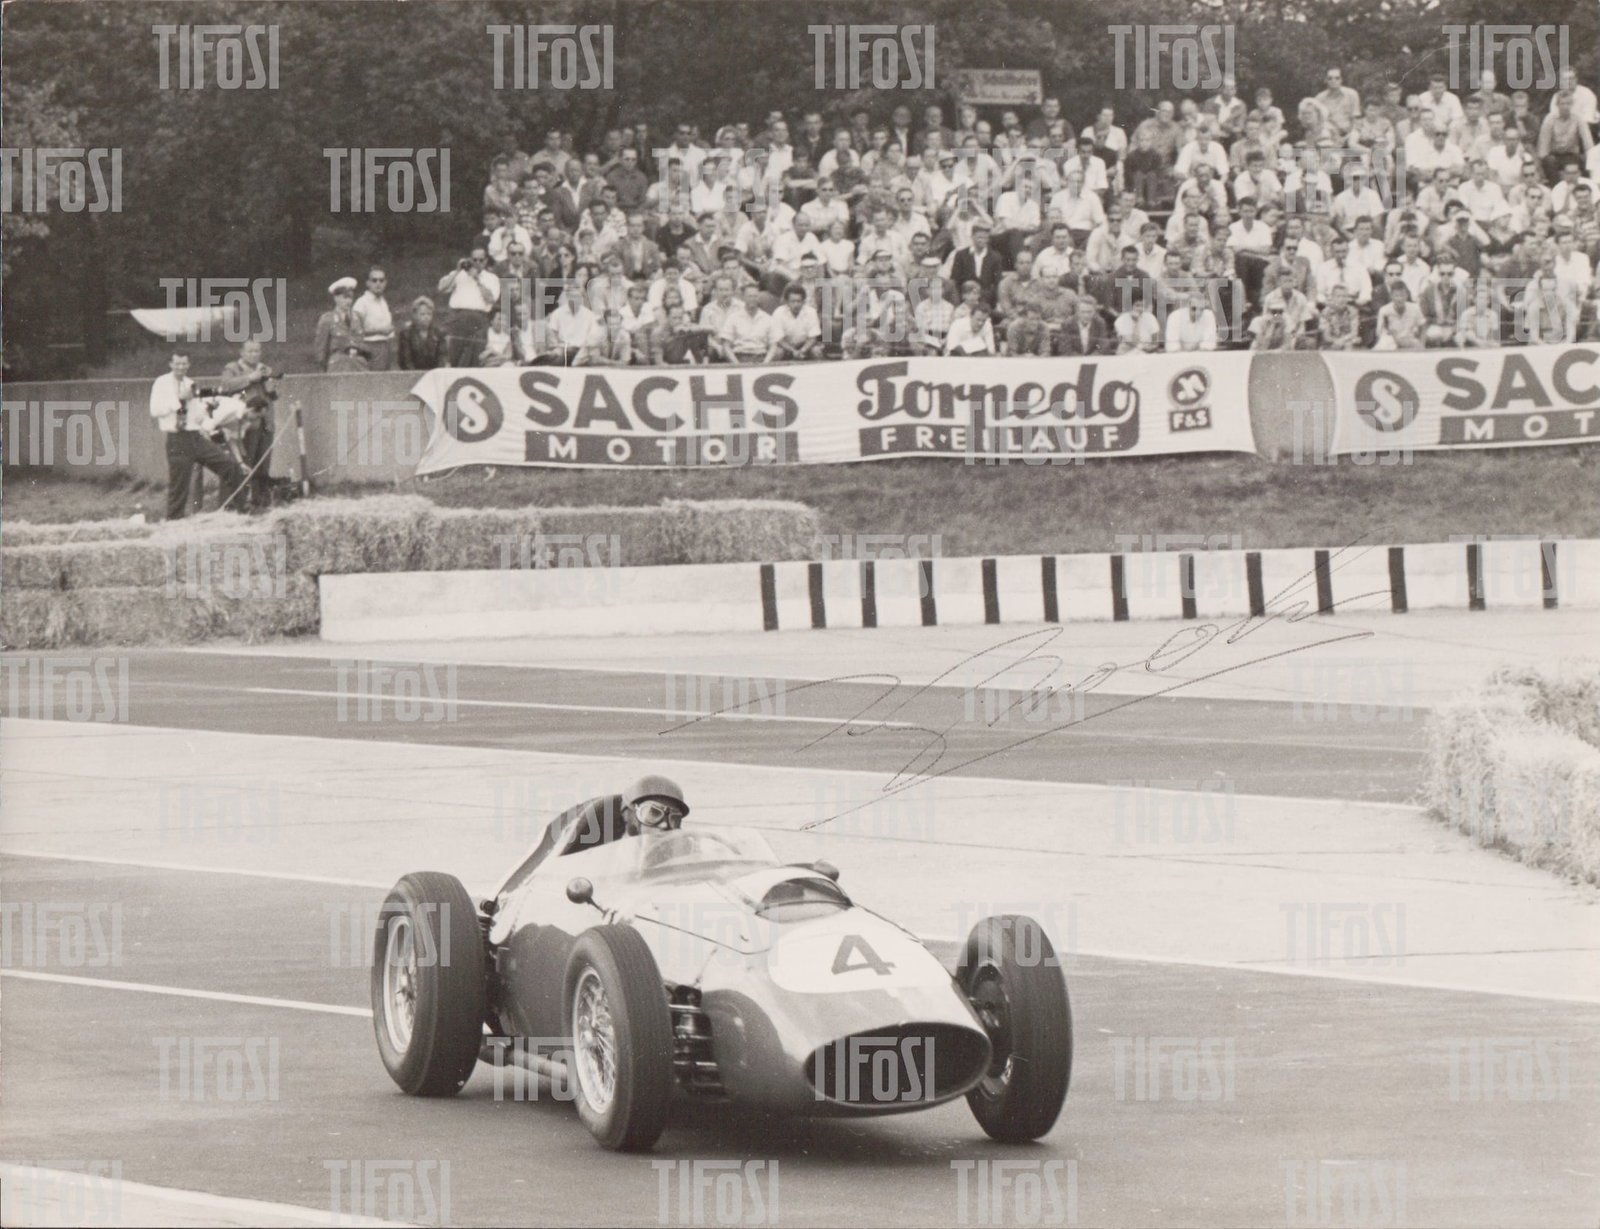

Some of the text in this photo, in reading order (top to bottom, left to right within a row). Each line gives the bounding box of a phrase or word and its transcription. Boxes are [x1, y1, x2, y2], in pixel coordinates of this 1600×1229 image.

[856, 361, 1140, 426] Torpedo
[1436, 348, 1600, 411] SAC
[519, 370, 799, 431] SACHS
[1172, 408, 1208, 430] F&S
[1463, 411, 1595, 441] MOT
[548, 434, 777, 461] MOTOR
[880, 425, 1120, 453] FREILAUF
[831, 934, 897, 976] 4
